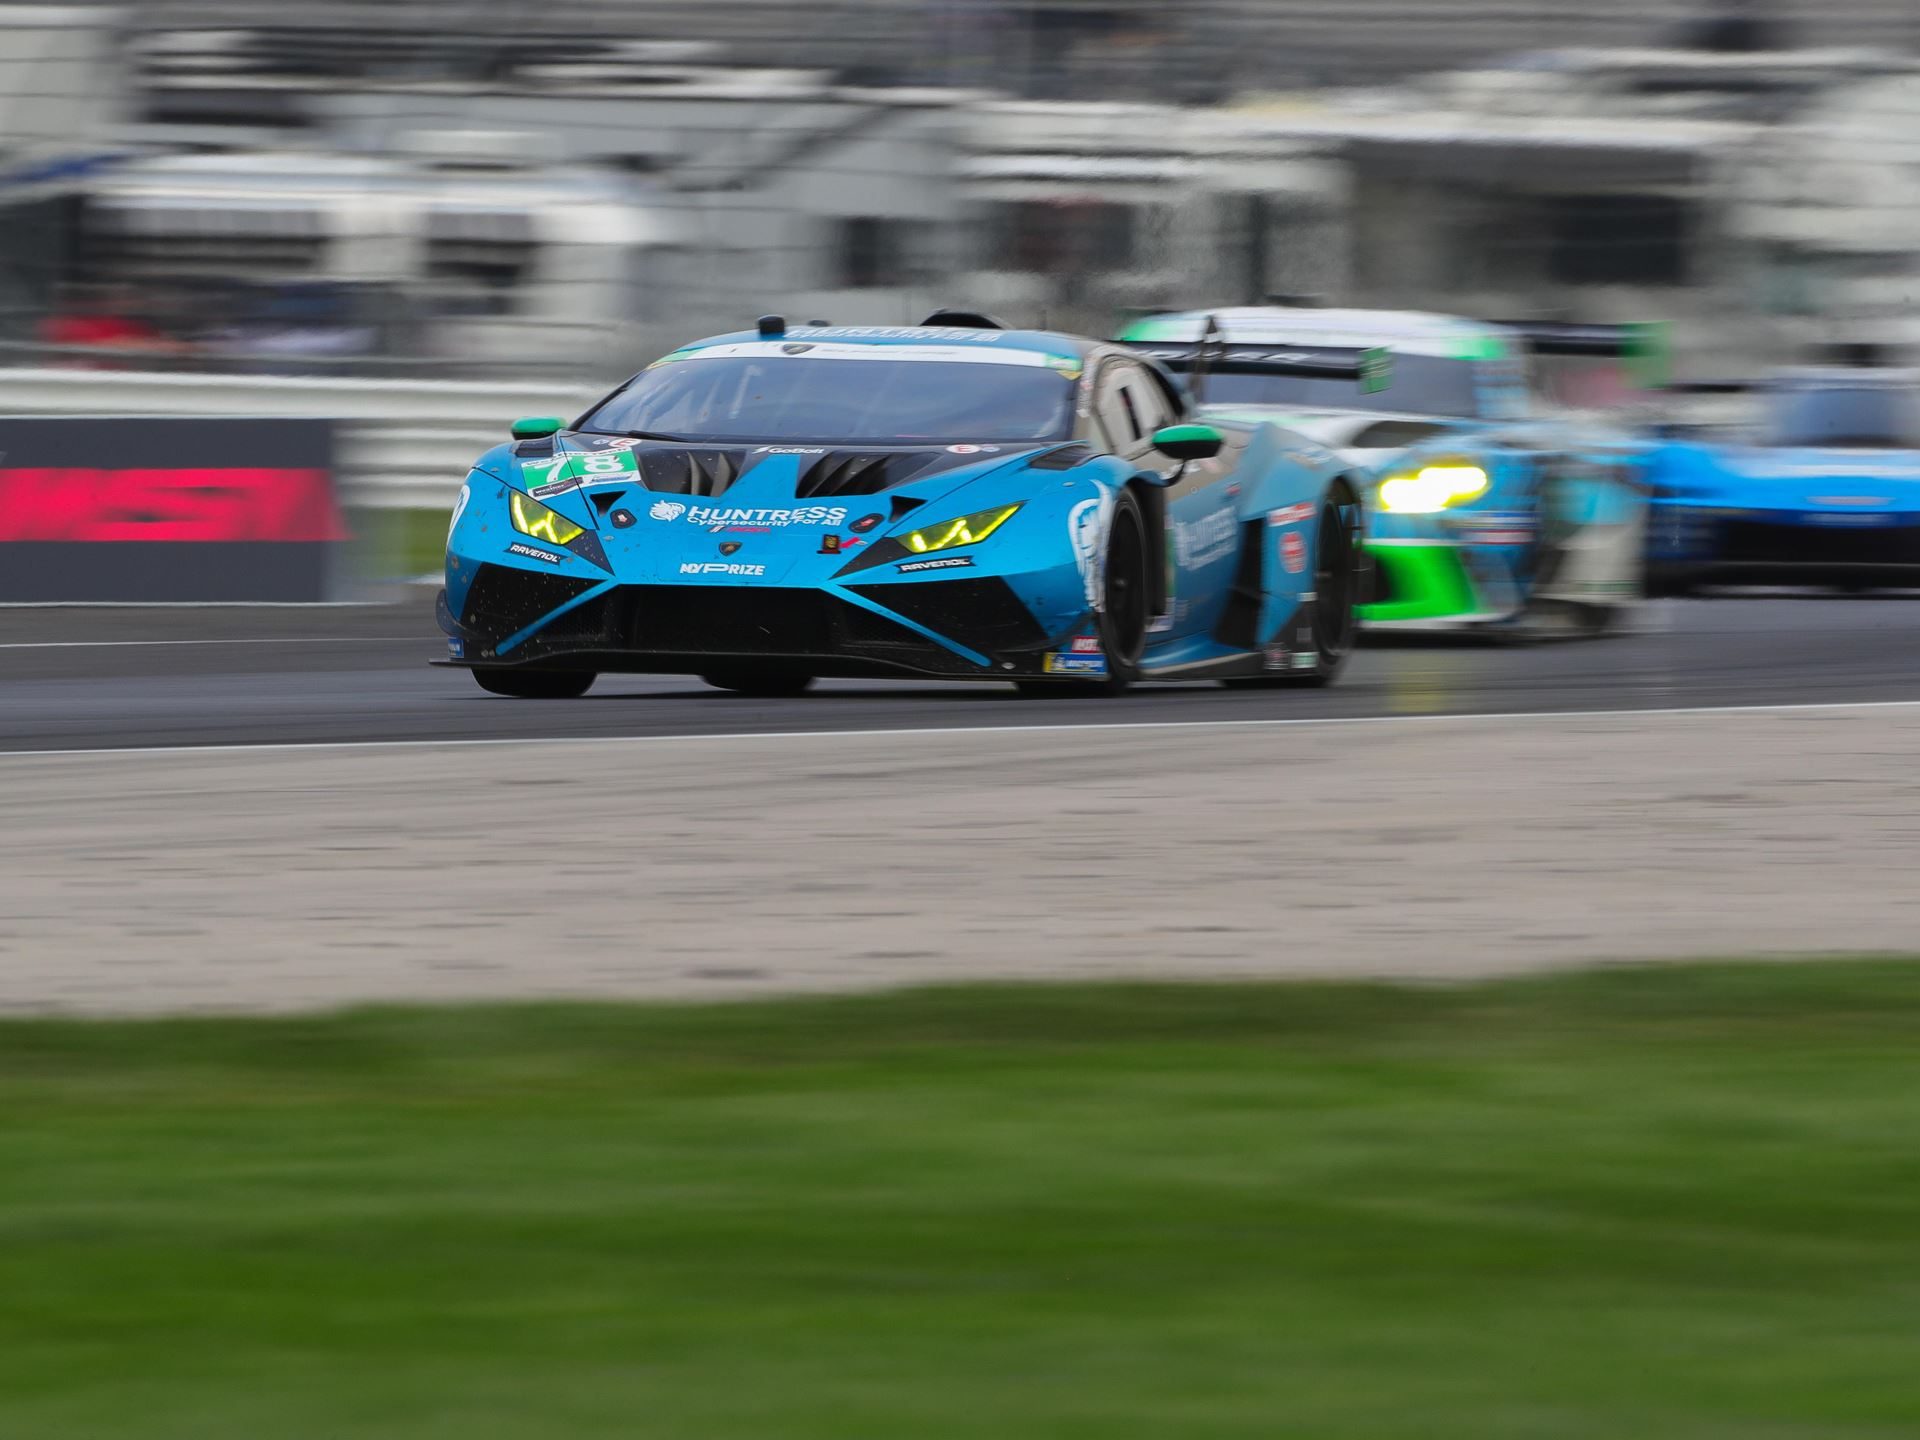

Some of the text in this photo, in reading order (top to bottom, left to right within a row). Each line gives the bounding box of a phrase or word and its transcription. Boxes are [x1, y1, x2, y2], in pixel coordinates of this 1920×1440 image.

[533, 454, 626, 483] 78
[687, 505, 849, 521] HUNTRESS
[687, 516, 842, 527] Cybersecurity For All
[510, 544, 560, 562] RAVENOL
[900, 558, 971, 571] RAVENOL
